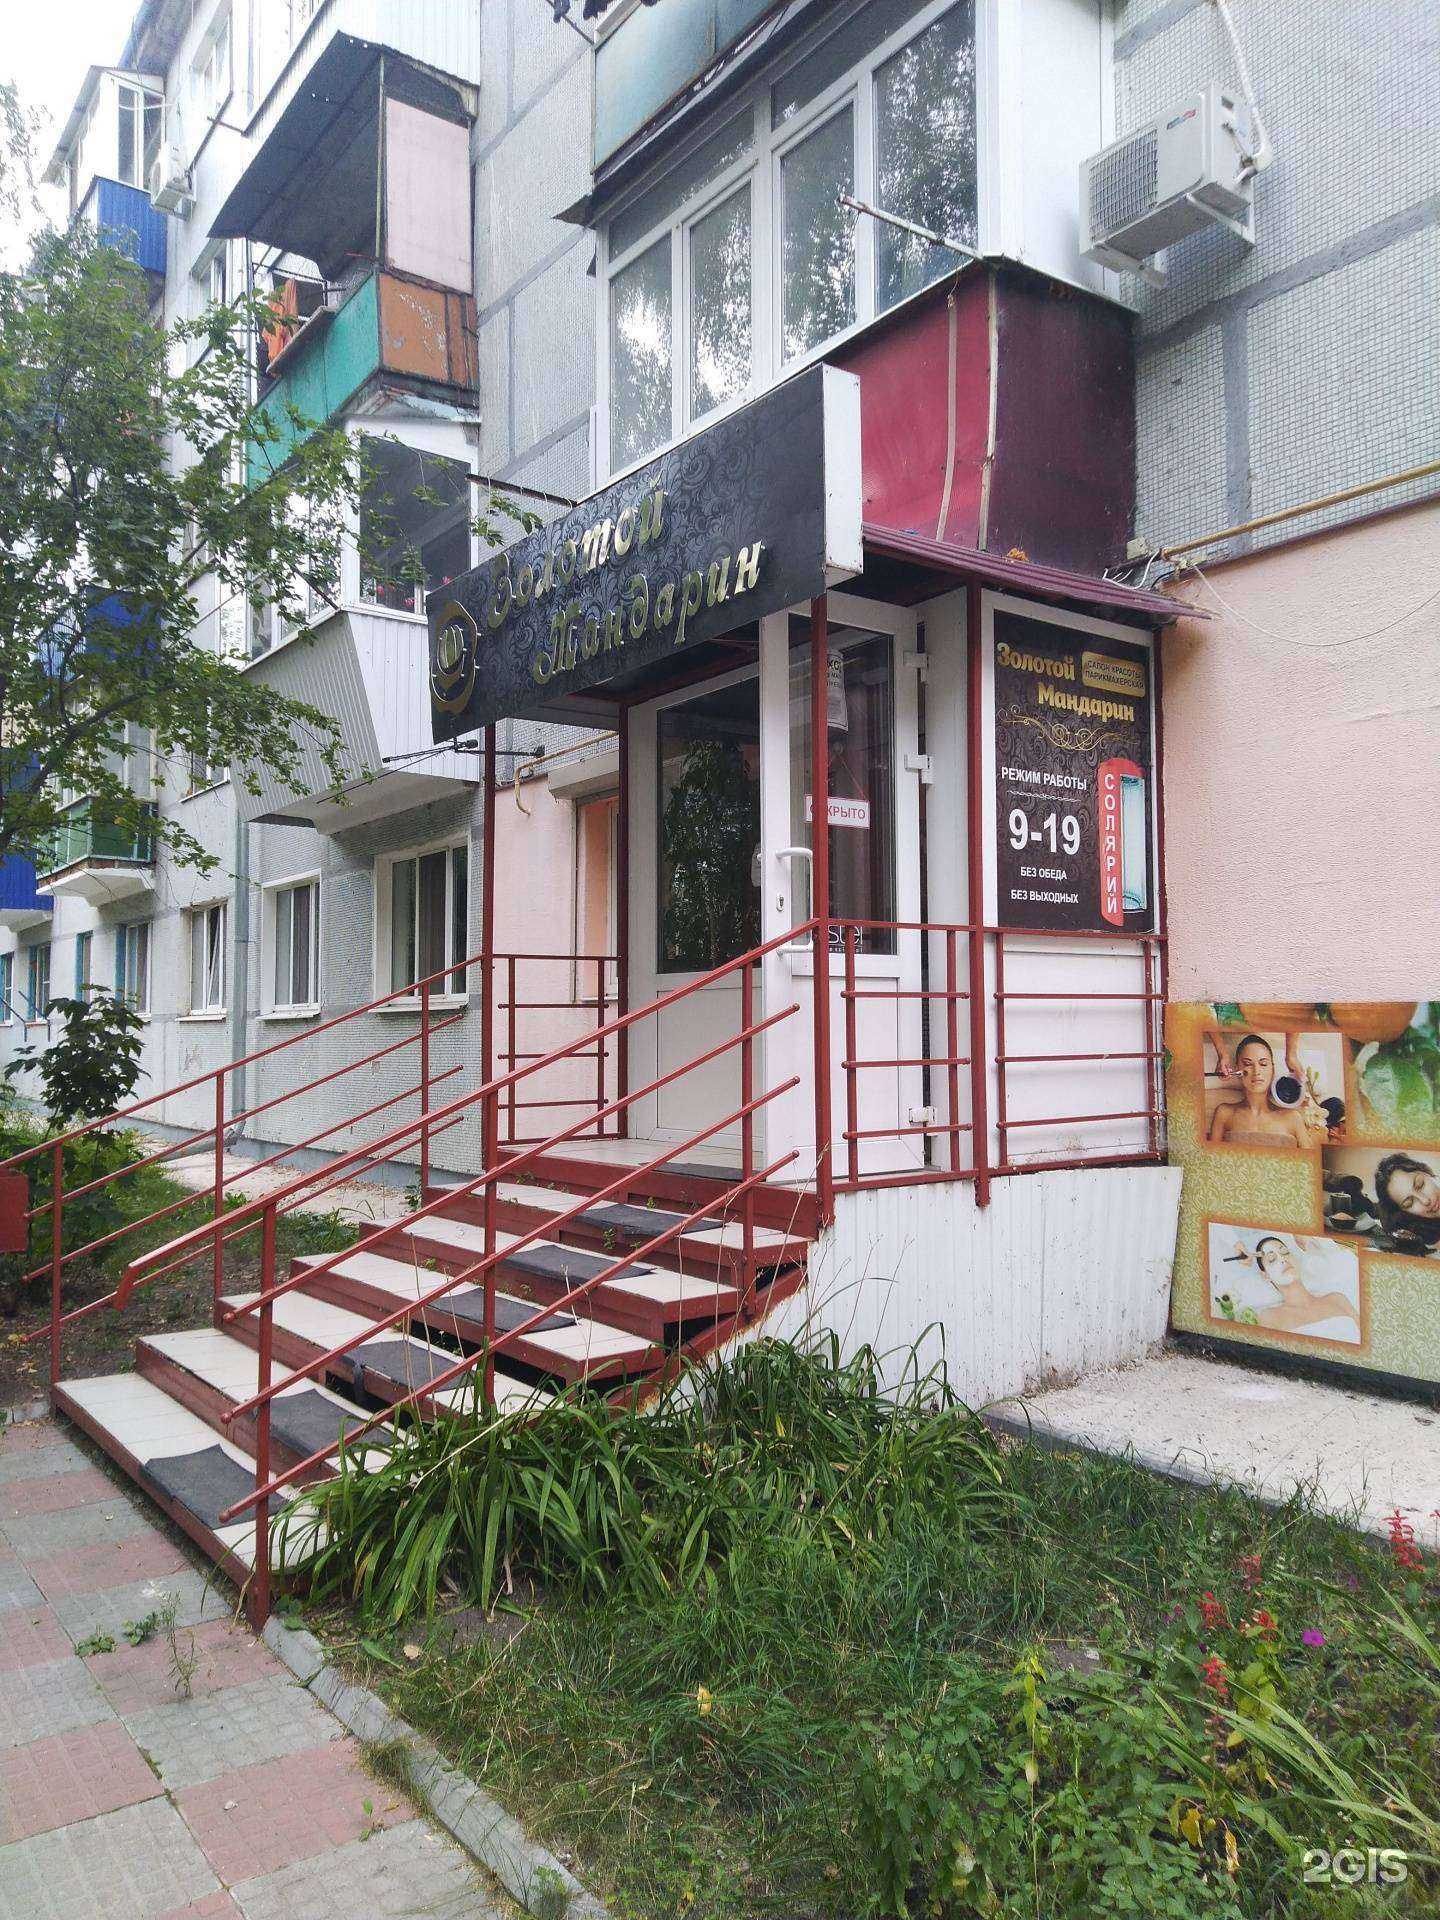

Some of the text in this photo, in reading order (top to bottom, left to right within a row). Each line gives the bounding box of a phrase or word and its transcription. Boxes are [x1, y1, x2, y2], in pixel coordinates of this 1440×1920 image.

[996, 642, 1075, 681] Золотой
[1037, 682, 1135, 722] Мандарин
[1001, 766, 1087, 791] РЕЖИМ РАБОТЫ
[810, 804, 866, 819] КРЫТО
[1008, 808, 1081, 855] 9-19
[1104, 773, 1118, 914] СОЛЯРИЙ
[1020, 866, 1067, 881] БЕЗ ОБЕДА
[1011, 889, 1079, 904] БЕЗ ВЫХОДНЫХ
